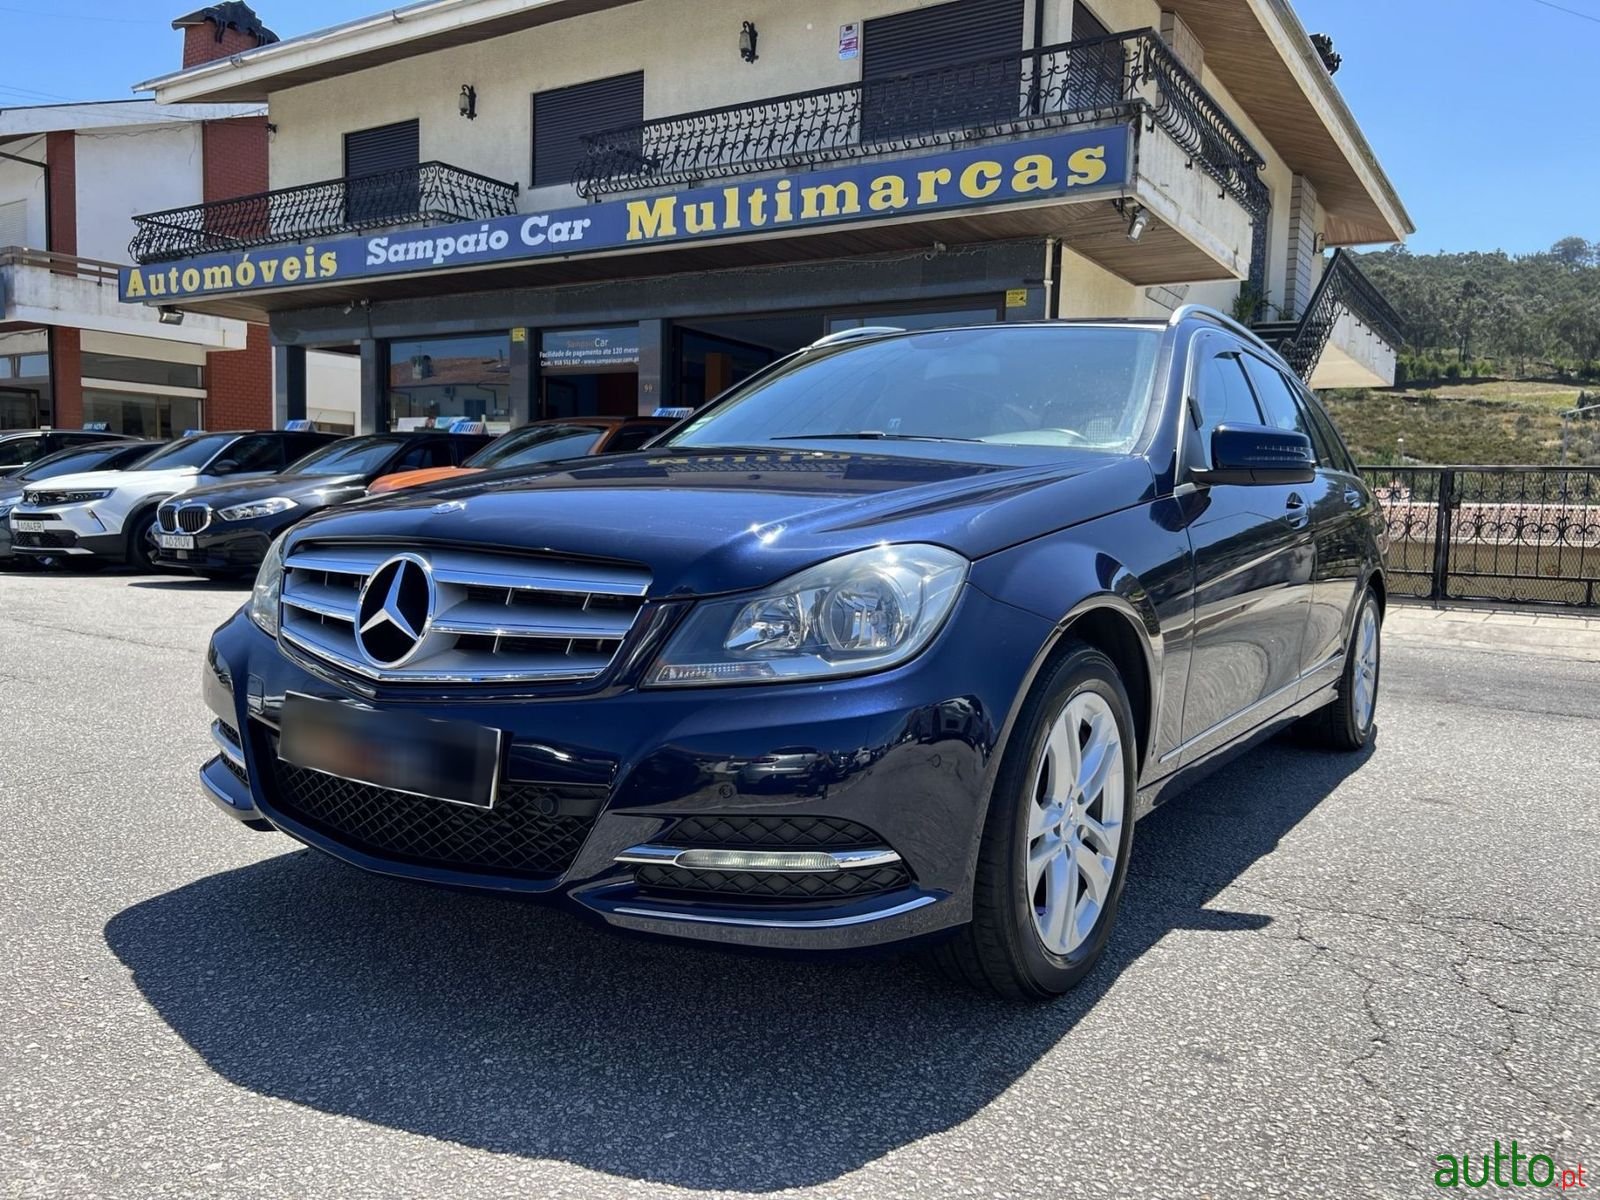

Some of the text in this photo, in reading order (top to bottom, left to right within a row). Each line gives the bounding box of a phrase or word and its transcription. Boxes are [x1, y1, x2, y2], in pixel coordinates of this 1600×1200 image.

[126, 145, 1107, 298] Automóveis Sampaio Car Multimarcas
[595, 337, 609, 348] Car
